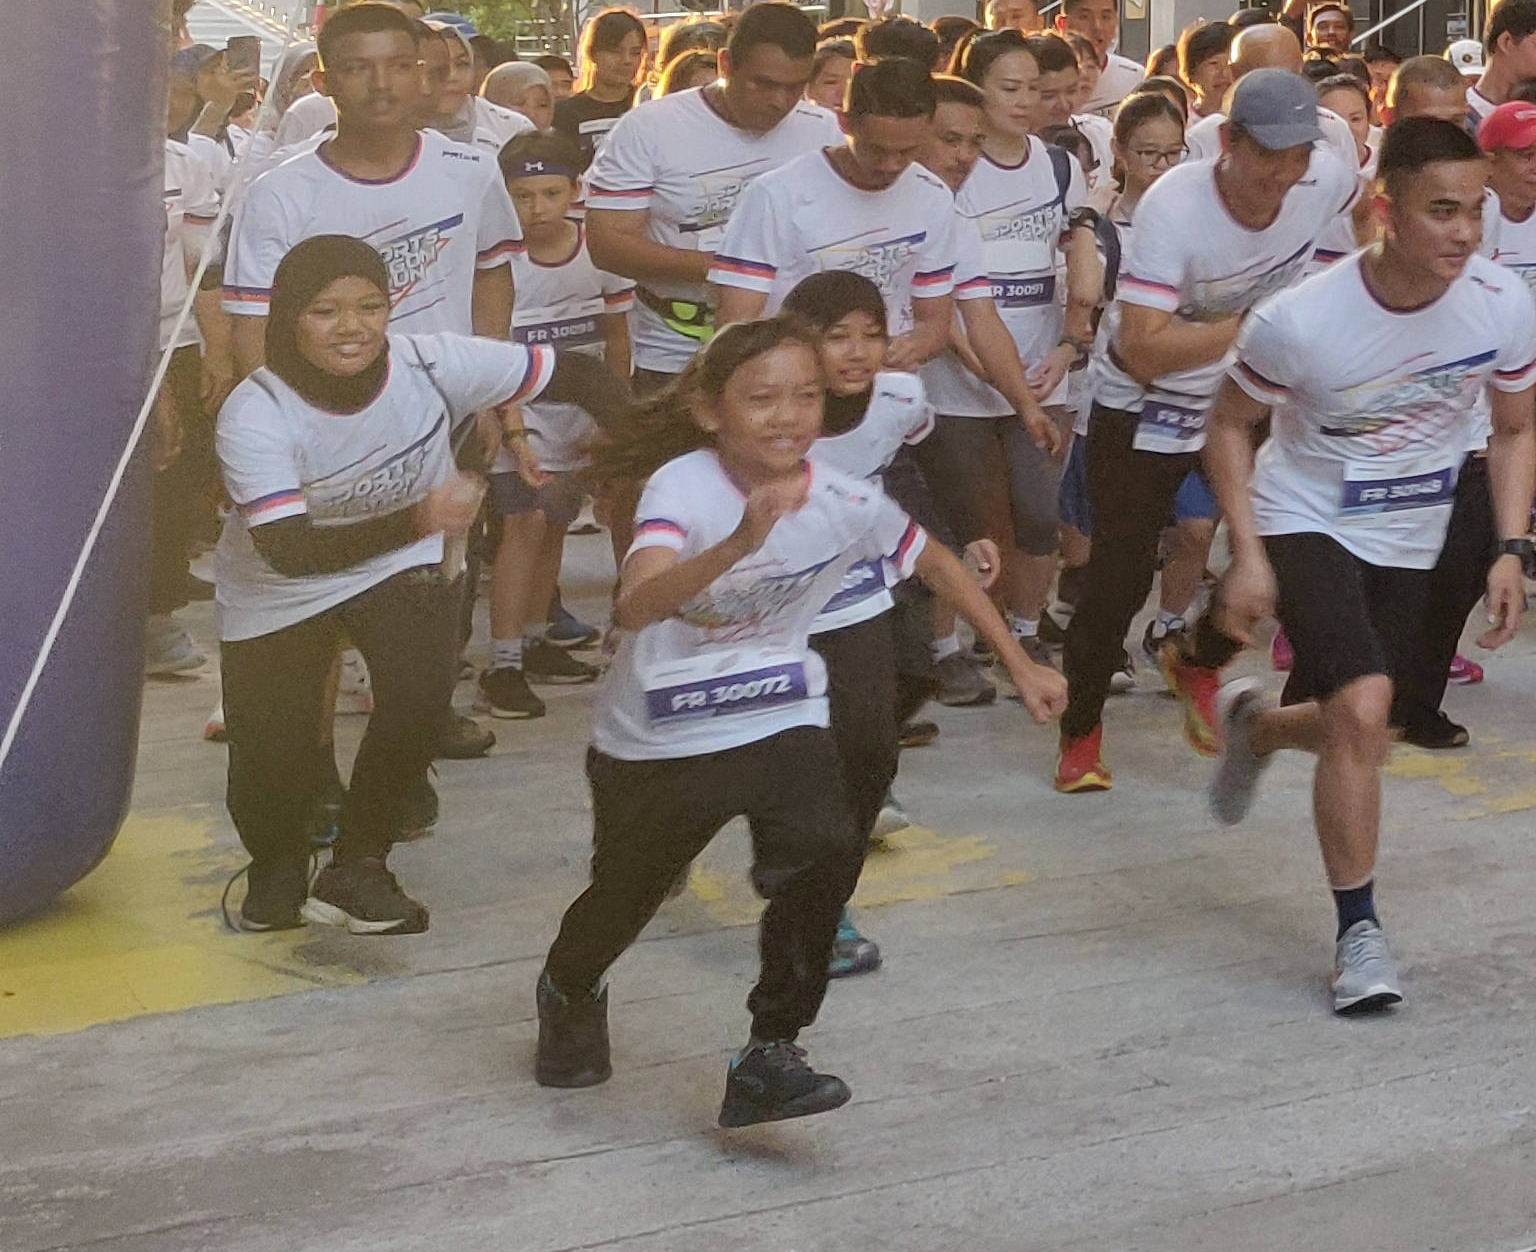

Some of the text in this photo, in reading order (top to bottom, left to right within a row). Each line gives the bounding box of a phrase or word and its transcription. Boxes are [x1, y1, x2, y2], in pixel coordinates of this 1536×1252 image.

[526, 330, 548, 343] FR
[670, 673, 794, 712] FR 30072
